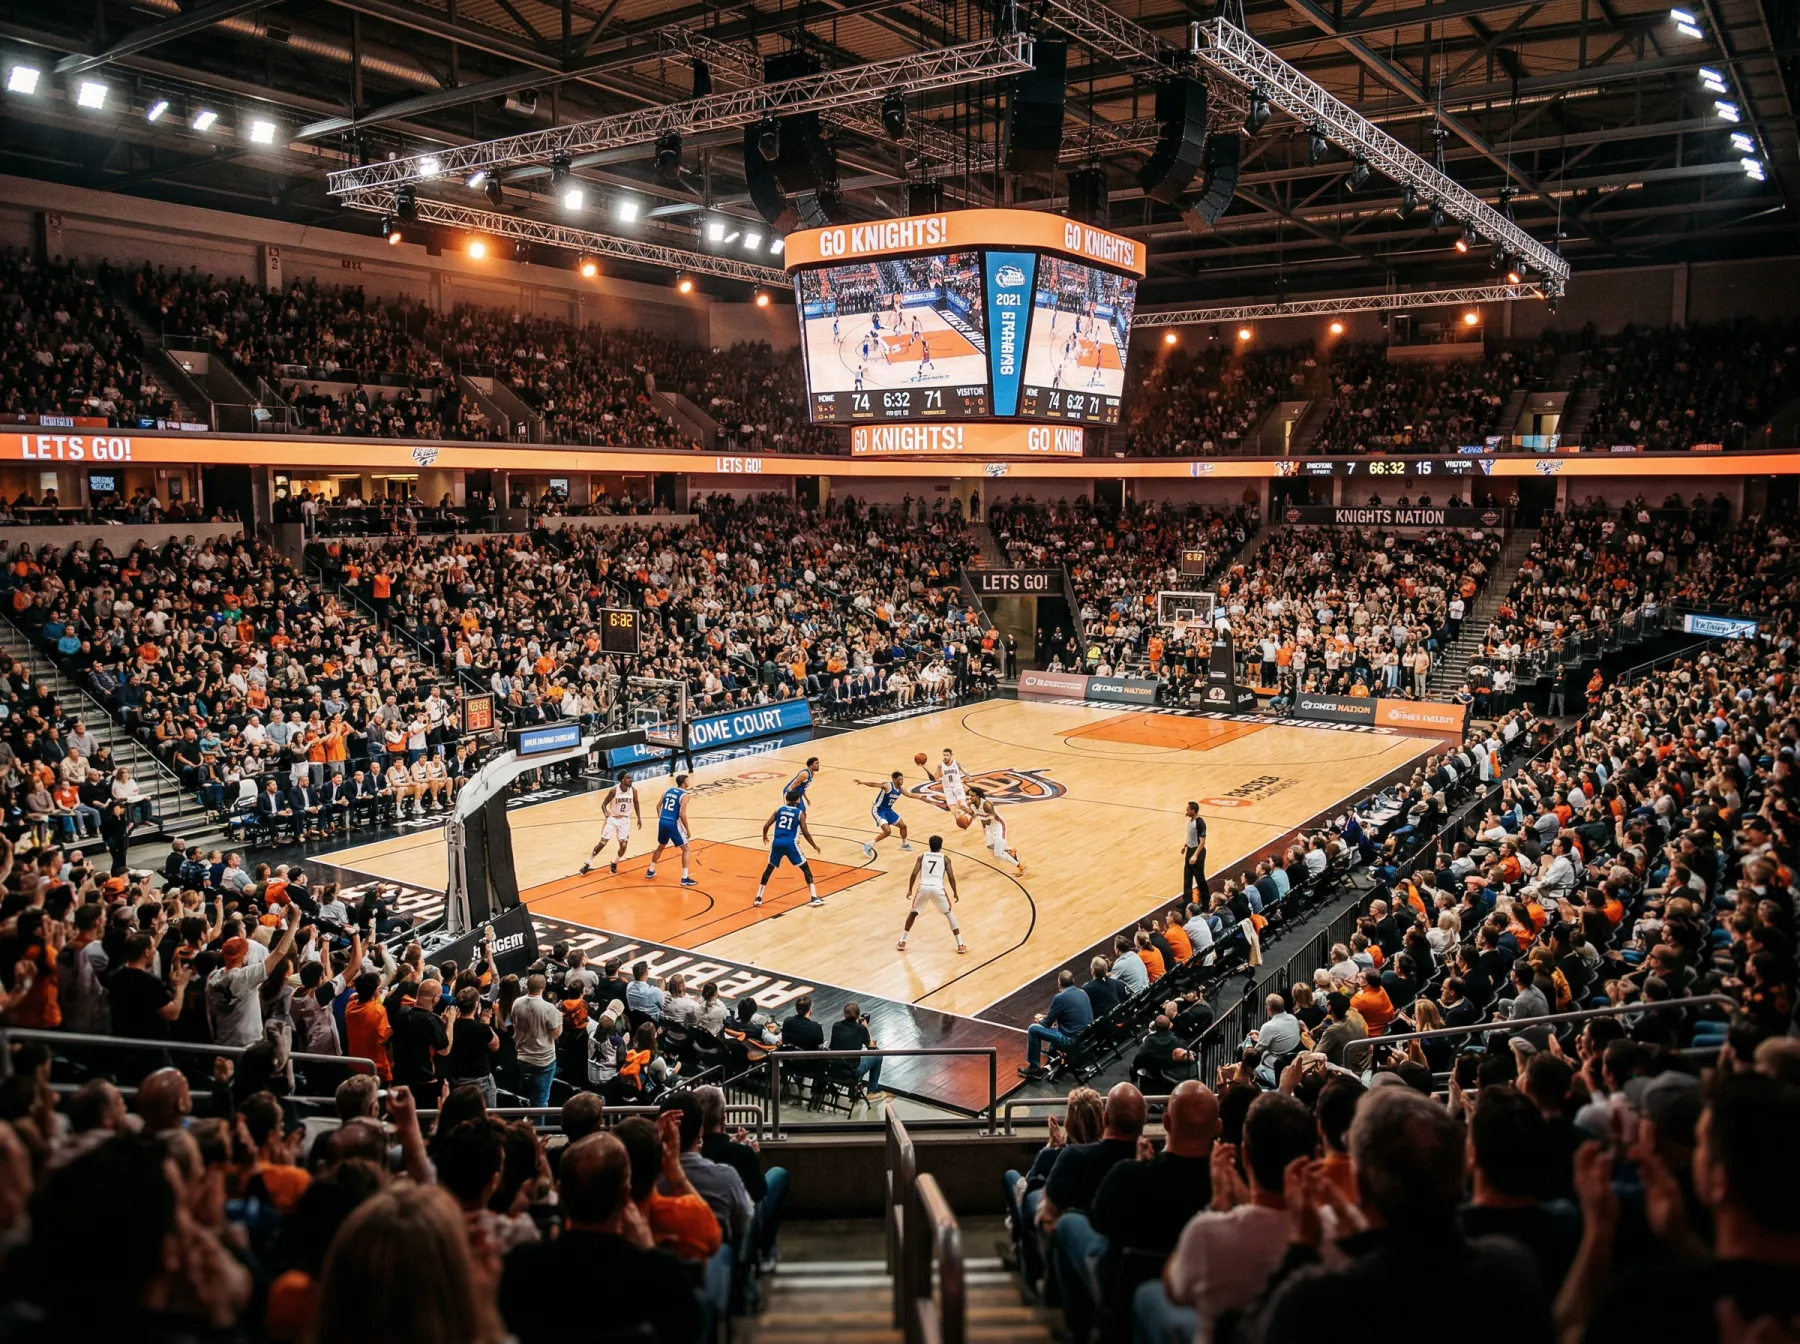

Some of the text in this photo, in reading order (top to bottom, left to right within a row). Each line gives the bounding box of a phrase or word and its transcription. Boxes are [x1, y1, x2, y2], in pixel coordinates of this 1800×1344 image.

[820, 216, 947, 257] GO KNIGHTS!
[1064, 222, 1135, 267] GO KNIGHTS!
[996, 293, 1022, 306] 2021
[883, 391, 911, 408] 6:32
[924, 389, 942, 409] 71
[956, 387, 984, 397] VISITOR
[851, 393, 870, 411] 74
[1048, 391, 1060, 410] 74
[1089, 396, 1100, 414] 71
[854, 426, 963, 452] GO KNIGHTS!
[1027, 427, 1050, 451] GO
[21, 435, 132, 461] LETS GO!
[716, 457, 762, 473] LETS GO!
[1346, 462, 1356, 475] 7
[1369, 461, 1405, 475] 66:32
[1415, 461, 1432, 475] 15
[1336, 509, 1445, 524] KNIGHTS NATION
[982, 574, 1048, 590] LETS GO!
[1337, 704, 1371, 714] NATION
[733, 709, 783, 736] COURT
[664, 798, 676, 811] 12
[778, 816, 793, 830] 21
[928, 860, 937, 874] 7
